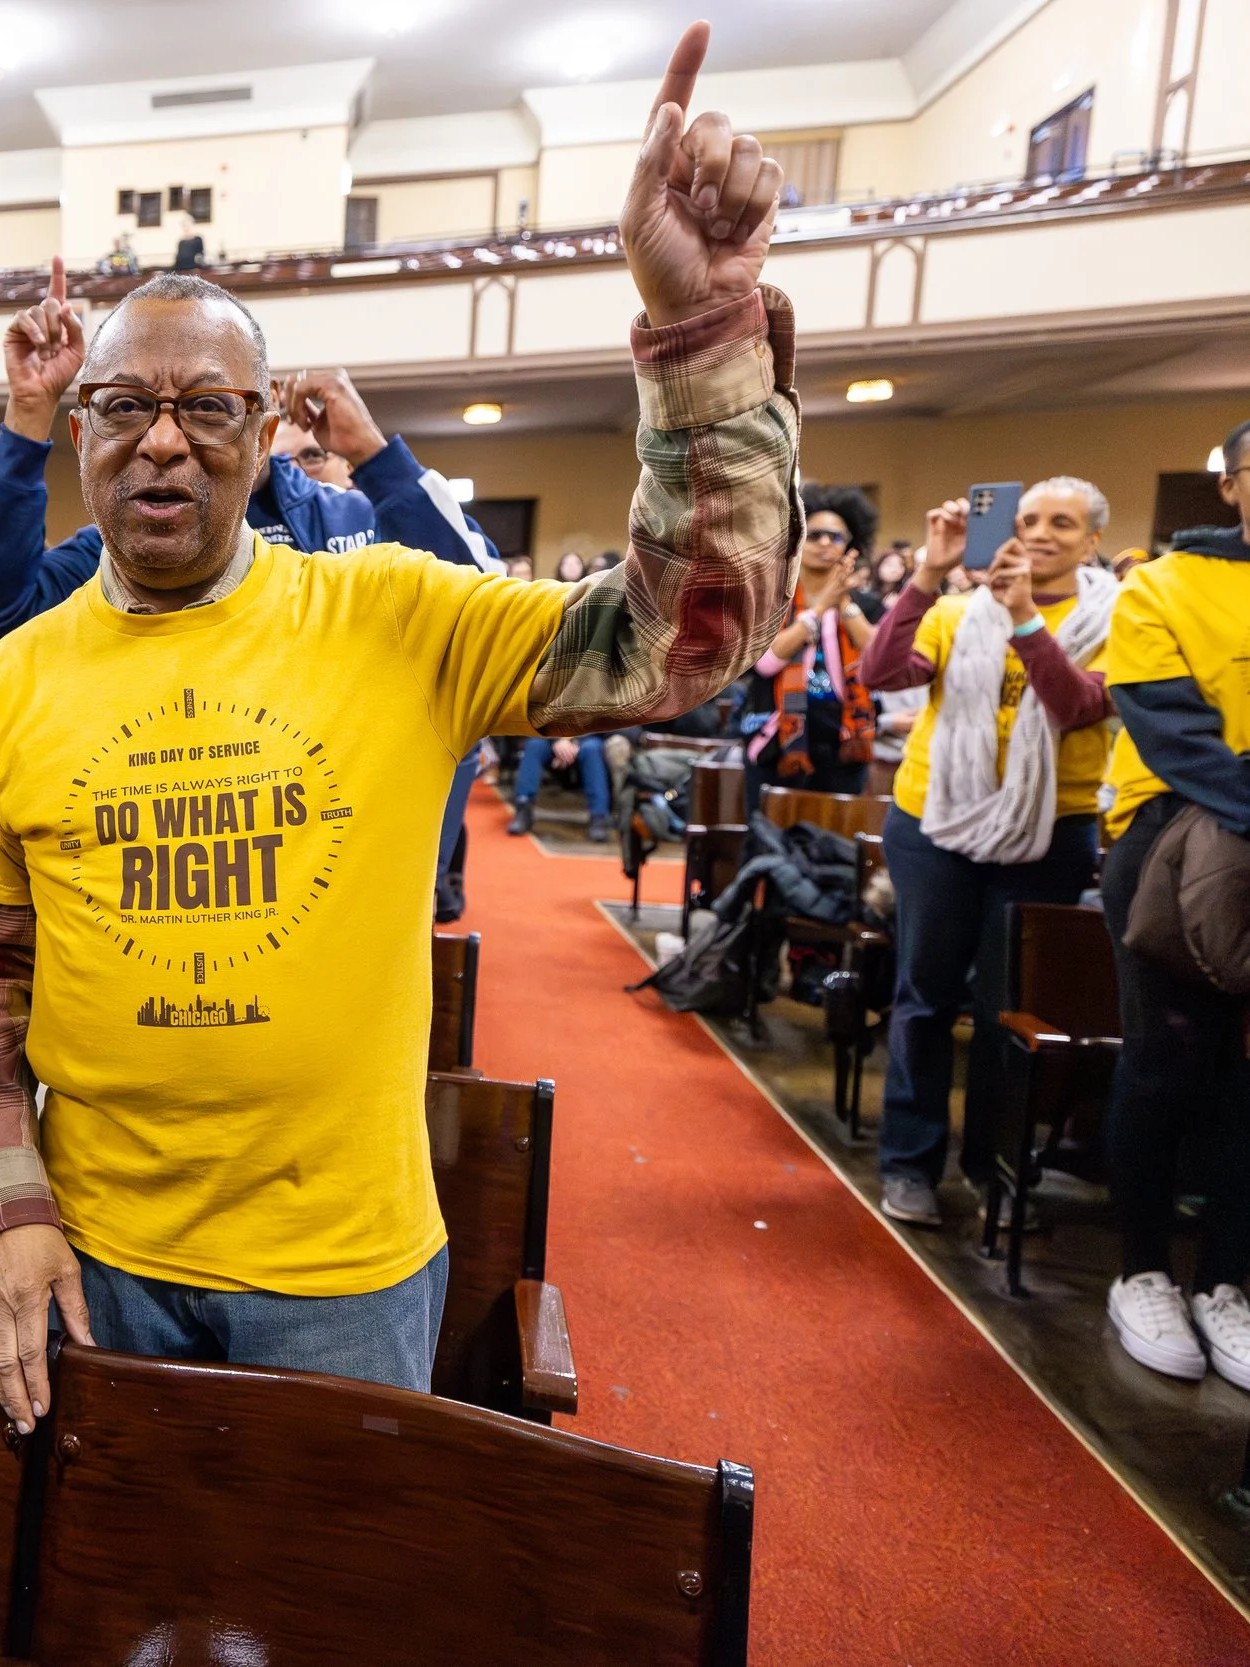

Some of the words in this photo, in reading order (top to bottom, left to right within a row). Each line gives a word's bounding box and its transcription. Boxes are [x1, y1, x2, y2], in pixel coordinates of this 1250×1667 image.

[185, 688, 194, 718] ONENESS
[129, 751, 155, 767] KING
[160, 749, 184, 763] DAY
[189, 747, 204, 760] OF
[209, 740, 260, 759] SERVICE
[92, 788, 117, 801] THE
[121, 785, 152, 797] TIME
[156, 783, 168, 794] IS
[172, 777, 232, 792] ALWAYS
[237, 770, 280, 786] RIGHT
[283, 766, 303, 778] TO
[95, 801, 139, 846] DO
[153, 789, 259, 838] WHAT
[272, 782, 307, 827] IS
[321, 808, 352, 820] TRUTH
[61, 840, 80, 850] UNITY
[120, 834, 283, 910] RIGHT
[121, 914, 137, 924] DR.
[140, 914, 182, 924] MARTIN
[186, 913, 231, 924] LUTHER
[235, 910, 261, 921] KING
[264, 907, 279, 919] JR.
[195, 953, 204, 984] JUSTICE
[170, 1010, 228, 1026] CHICAGO
